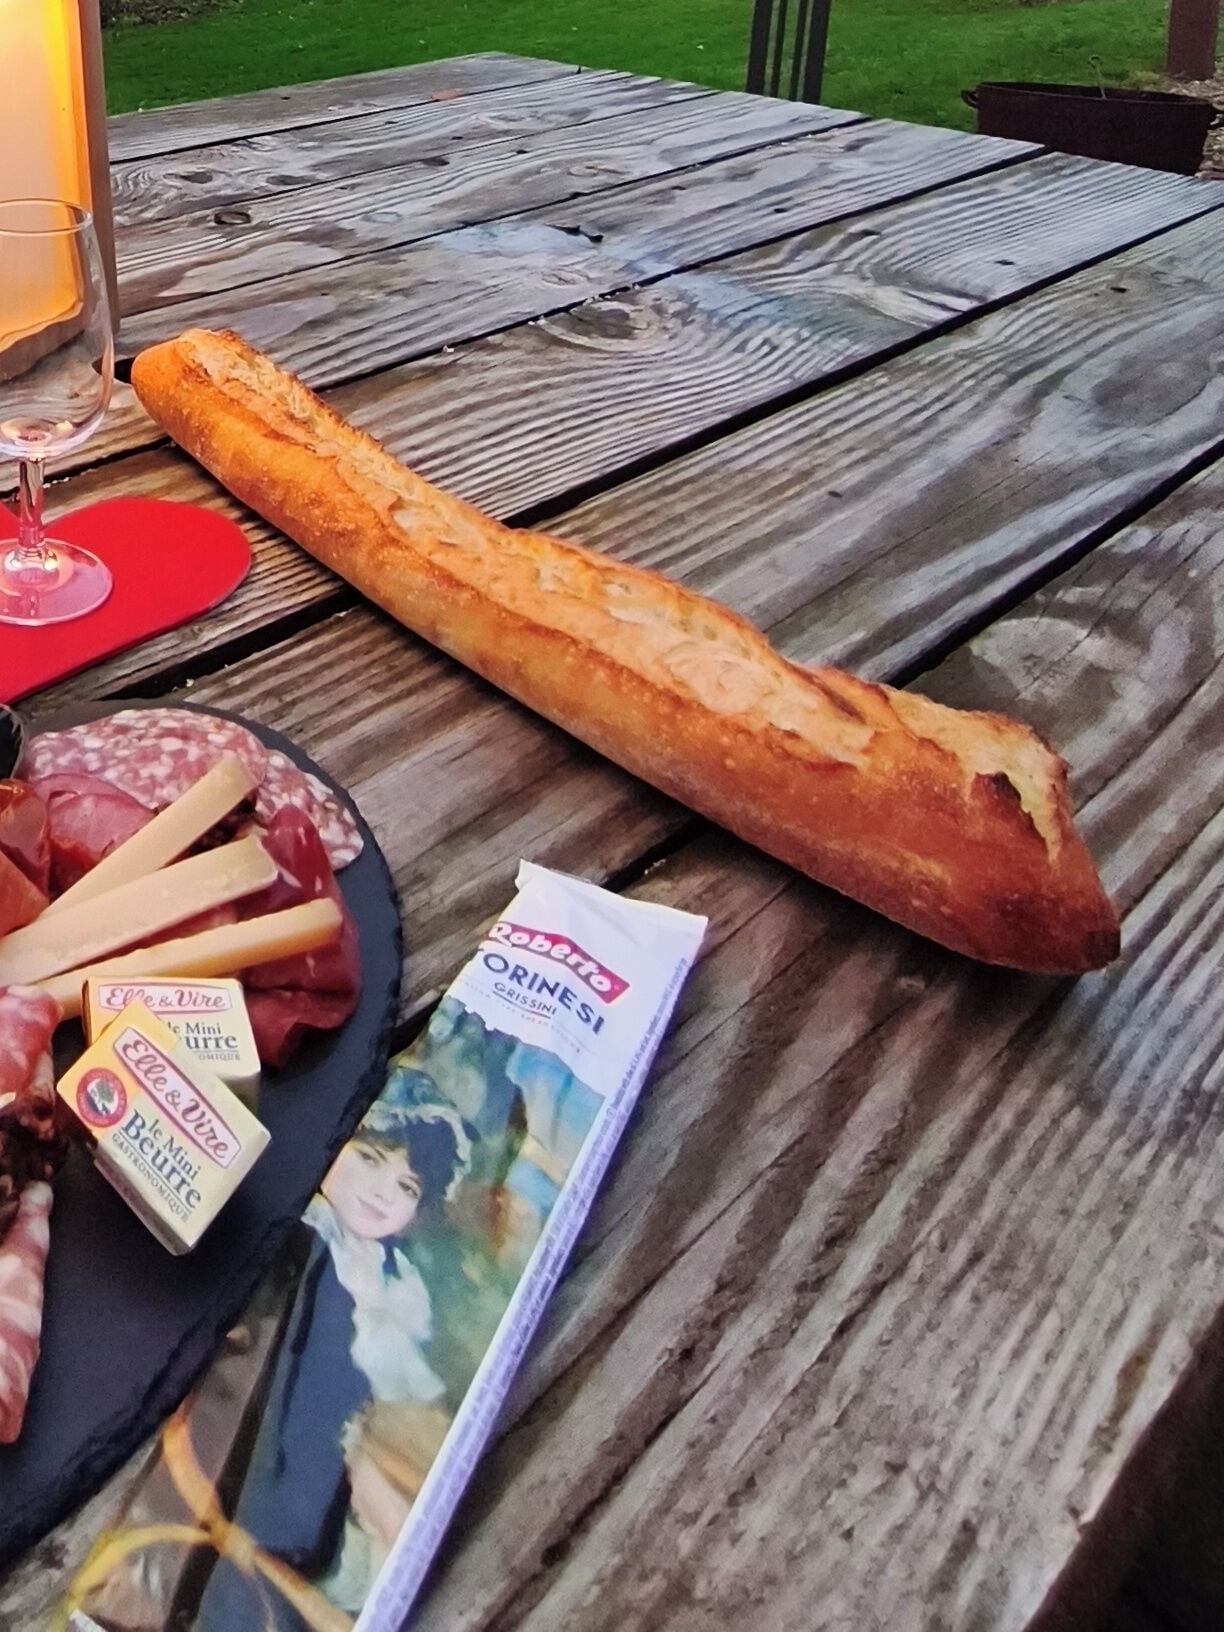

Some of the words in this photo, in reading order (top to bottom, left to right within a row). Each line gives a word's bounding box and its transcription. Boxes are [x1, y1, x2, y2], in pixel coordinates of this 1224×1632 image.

[488, 922, 612, 992] Roberto
[159, 993, 174, 1007] &
[176, 989, 226, 1009] Vire
[481, 952, 605, 1035] ORINESI
[494, 982, 558, 1016] GRISSINI
[182, 1035, 238, 1050] urre
[185, 1021, 222, 1035] Mini
[121, 1038, 168, 1090] Elle
[165, 1089, 183, 1112] &
[181, 1097, 231, 1160] Vire
[111, 1133, 191, 1223] GASTRONOMIQUE
[121, 1108, 202, 1209] Beurre
[148, 1119, 164, 1141] le
[163, 1135, 202, 1181] Mini
